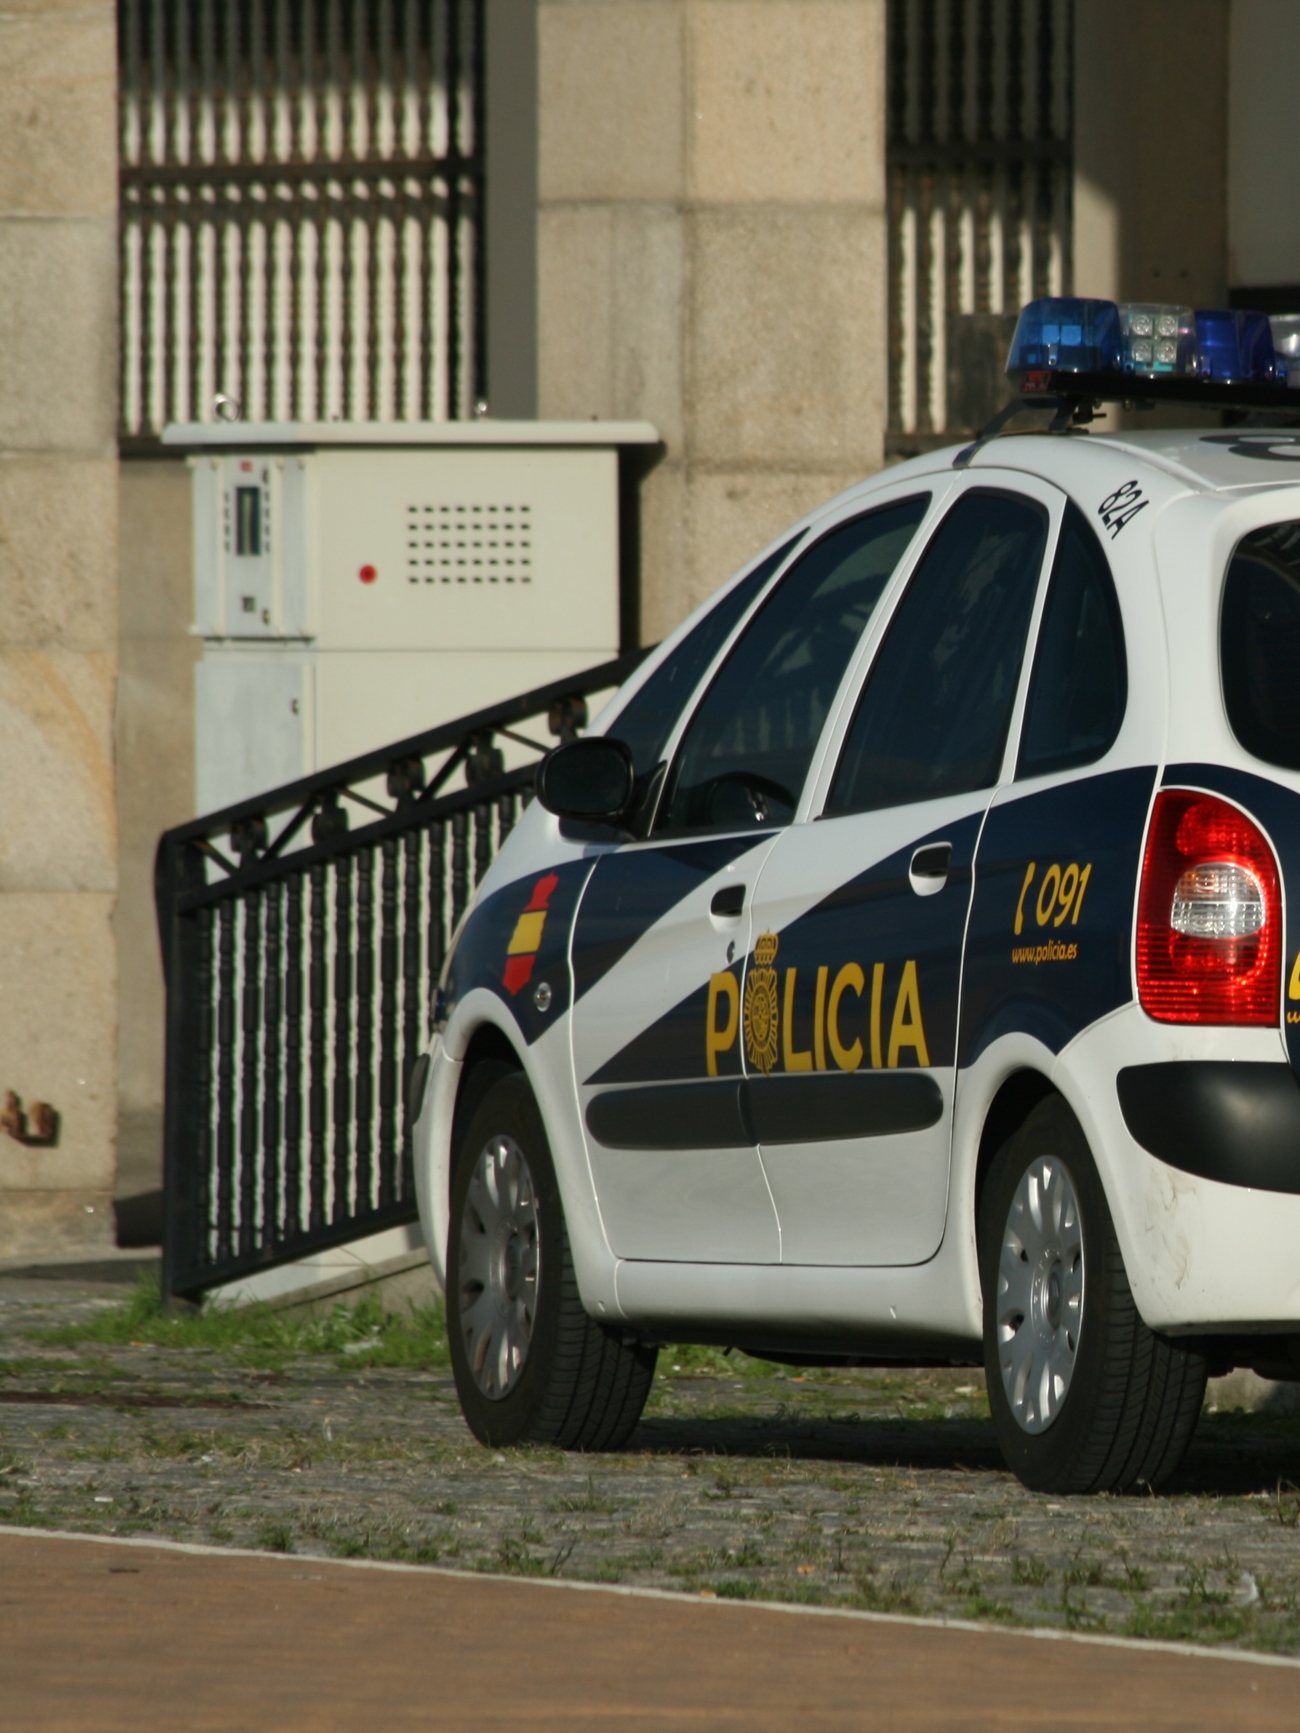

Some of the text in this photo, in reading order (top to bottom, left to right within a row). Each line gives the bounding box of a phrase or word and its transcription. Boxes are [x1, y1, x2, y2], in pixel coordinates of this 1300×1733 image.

[1097, 479, 1150, 541] 82A
[1036, 862, 1092, 928] 091
[1011, 939, 1078, 966] www.policia.es
